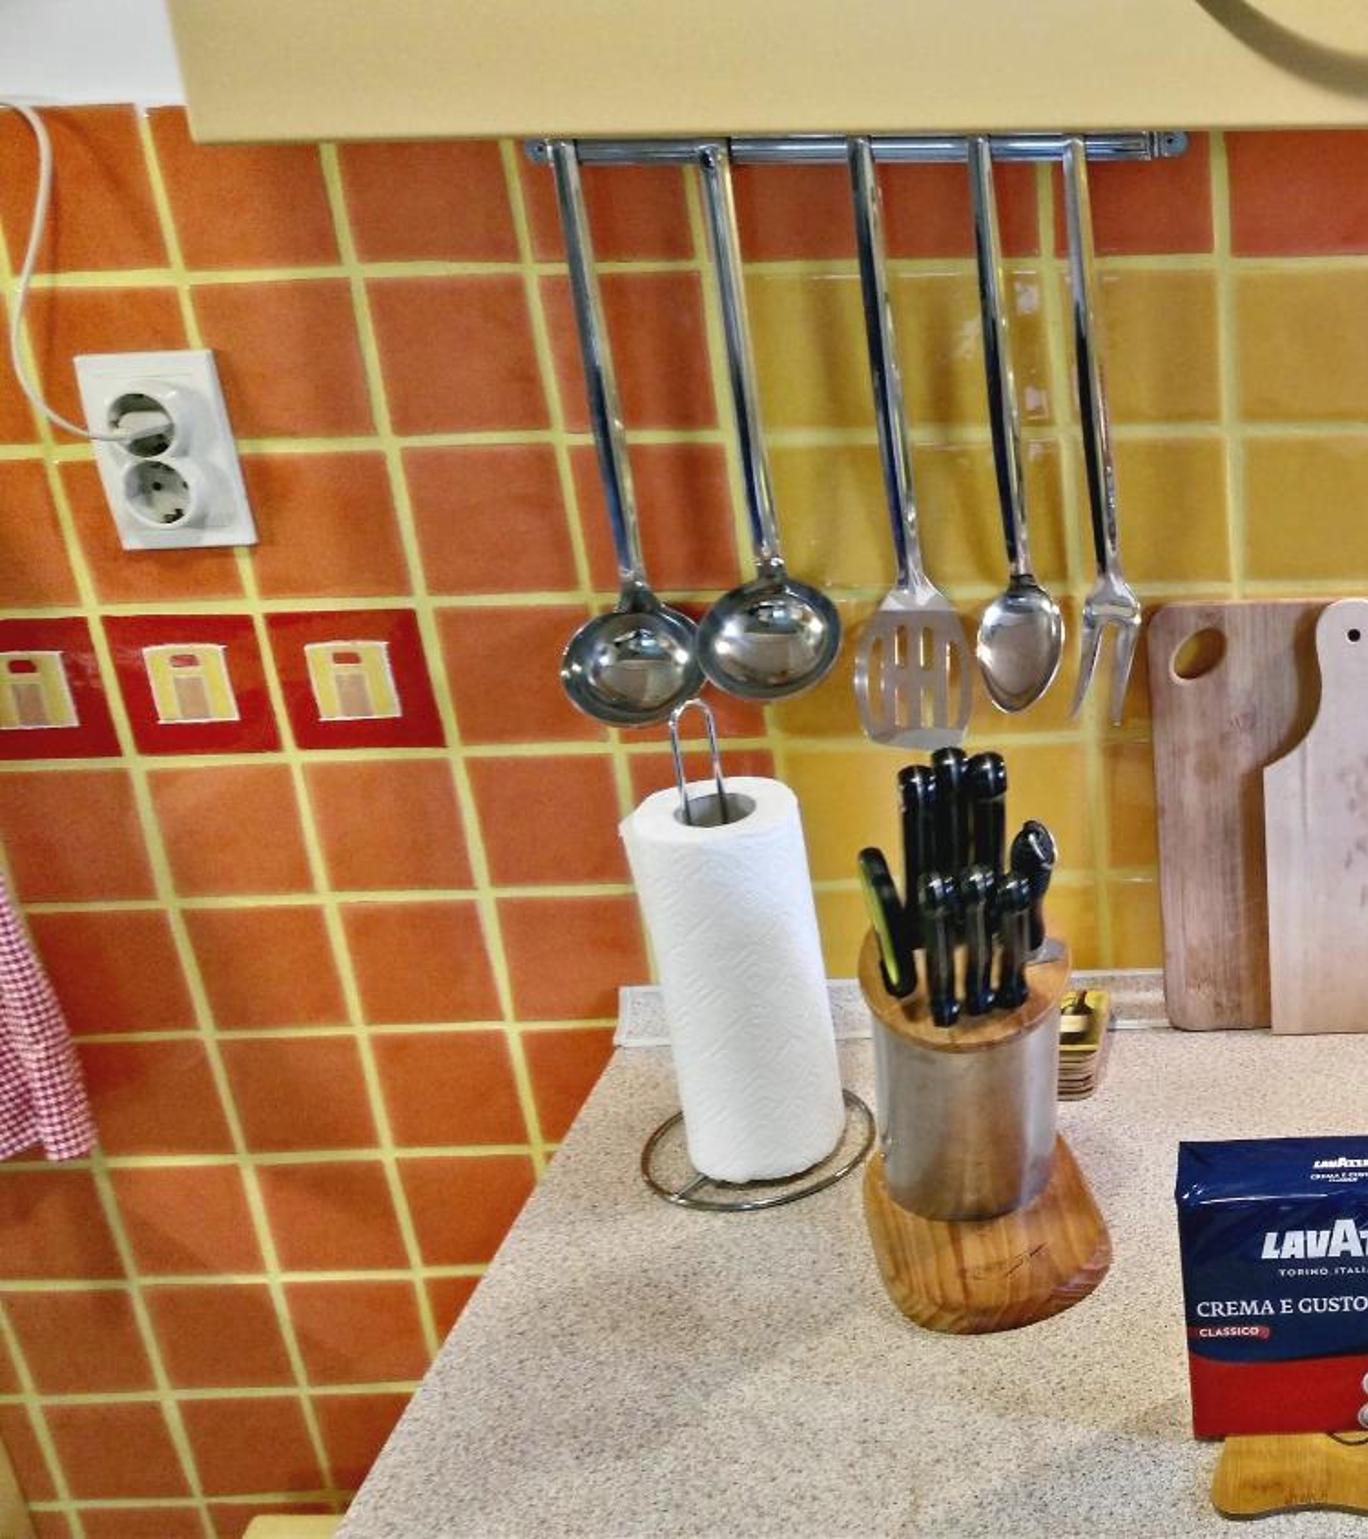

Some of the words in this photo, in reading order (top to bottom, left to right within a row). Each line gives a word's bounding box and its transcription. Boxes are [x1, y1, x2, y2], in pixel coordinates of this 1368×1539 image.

[1197, 1300, 1275, 1318] CREMA
[1280, 1299, 1294, 1314] E
[1298, 1295, 1368, 1314] GUSTO
[1199, 1326, 1259, 1337] CLASSICO
